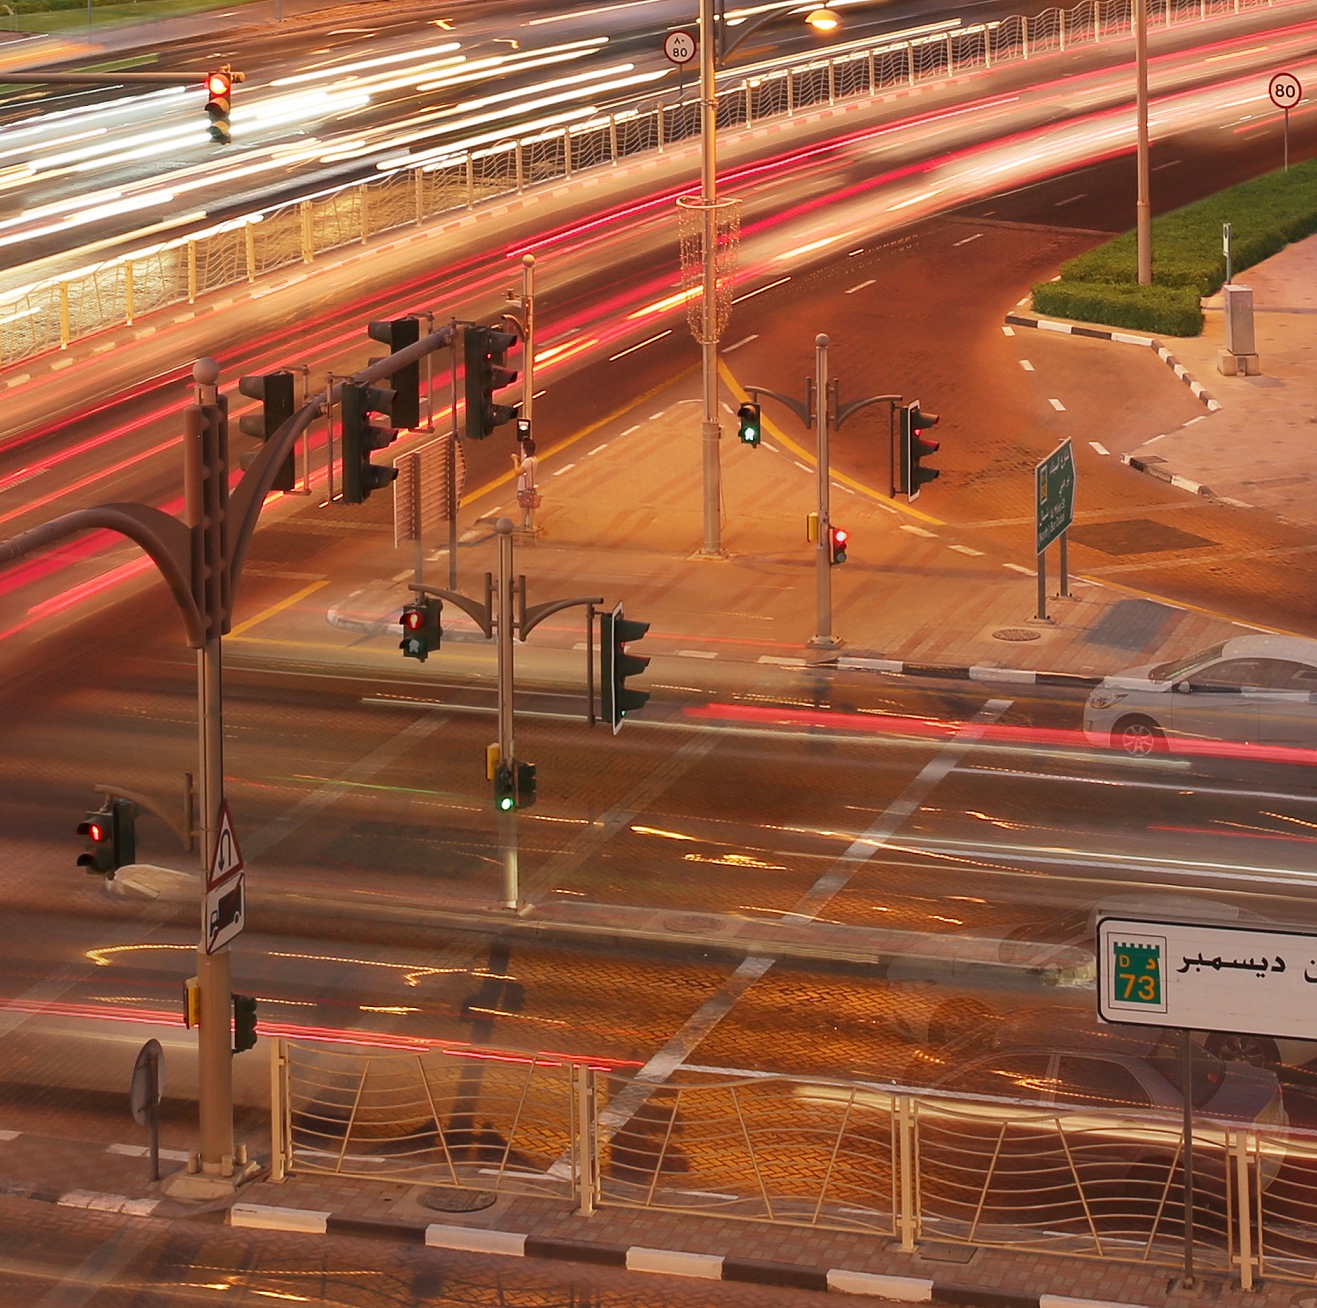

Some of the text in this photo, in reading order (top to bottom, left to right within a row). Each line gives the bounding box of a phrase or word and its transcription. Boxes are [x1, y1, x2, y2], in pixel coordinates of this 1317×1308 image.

[672, 47, 688, 58] 80
[1275, 83, 1296, 98] 80
[1176, 952, 1286, 978] ديسمبر
[1119, 973, 1156, 1001] 73
